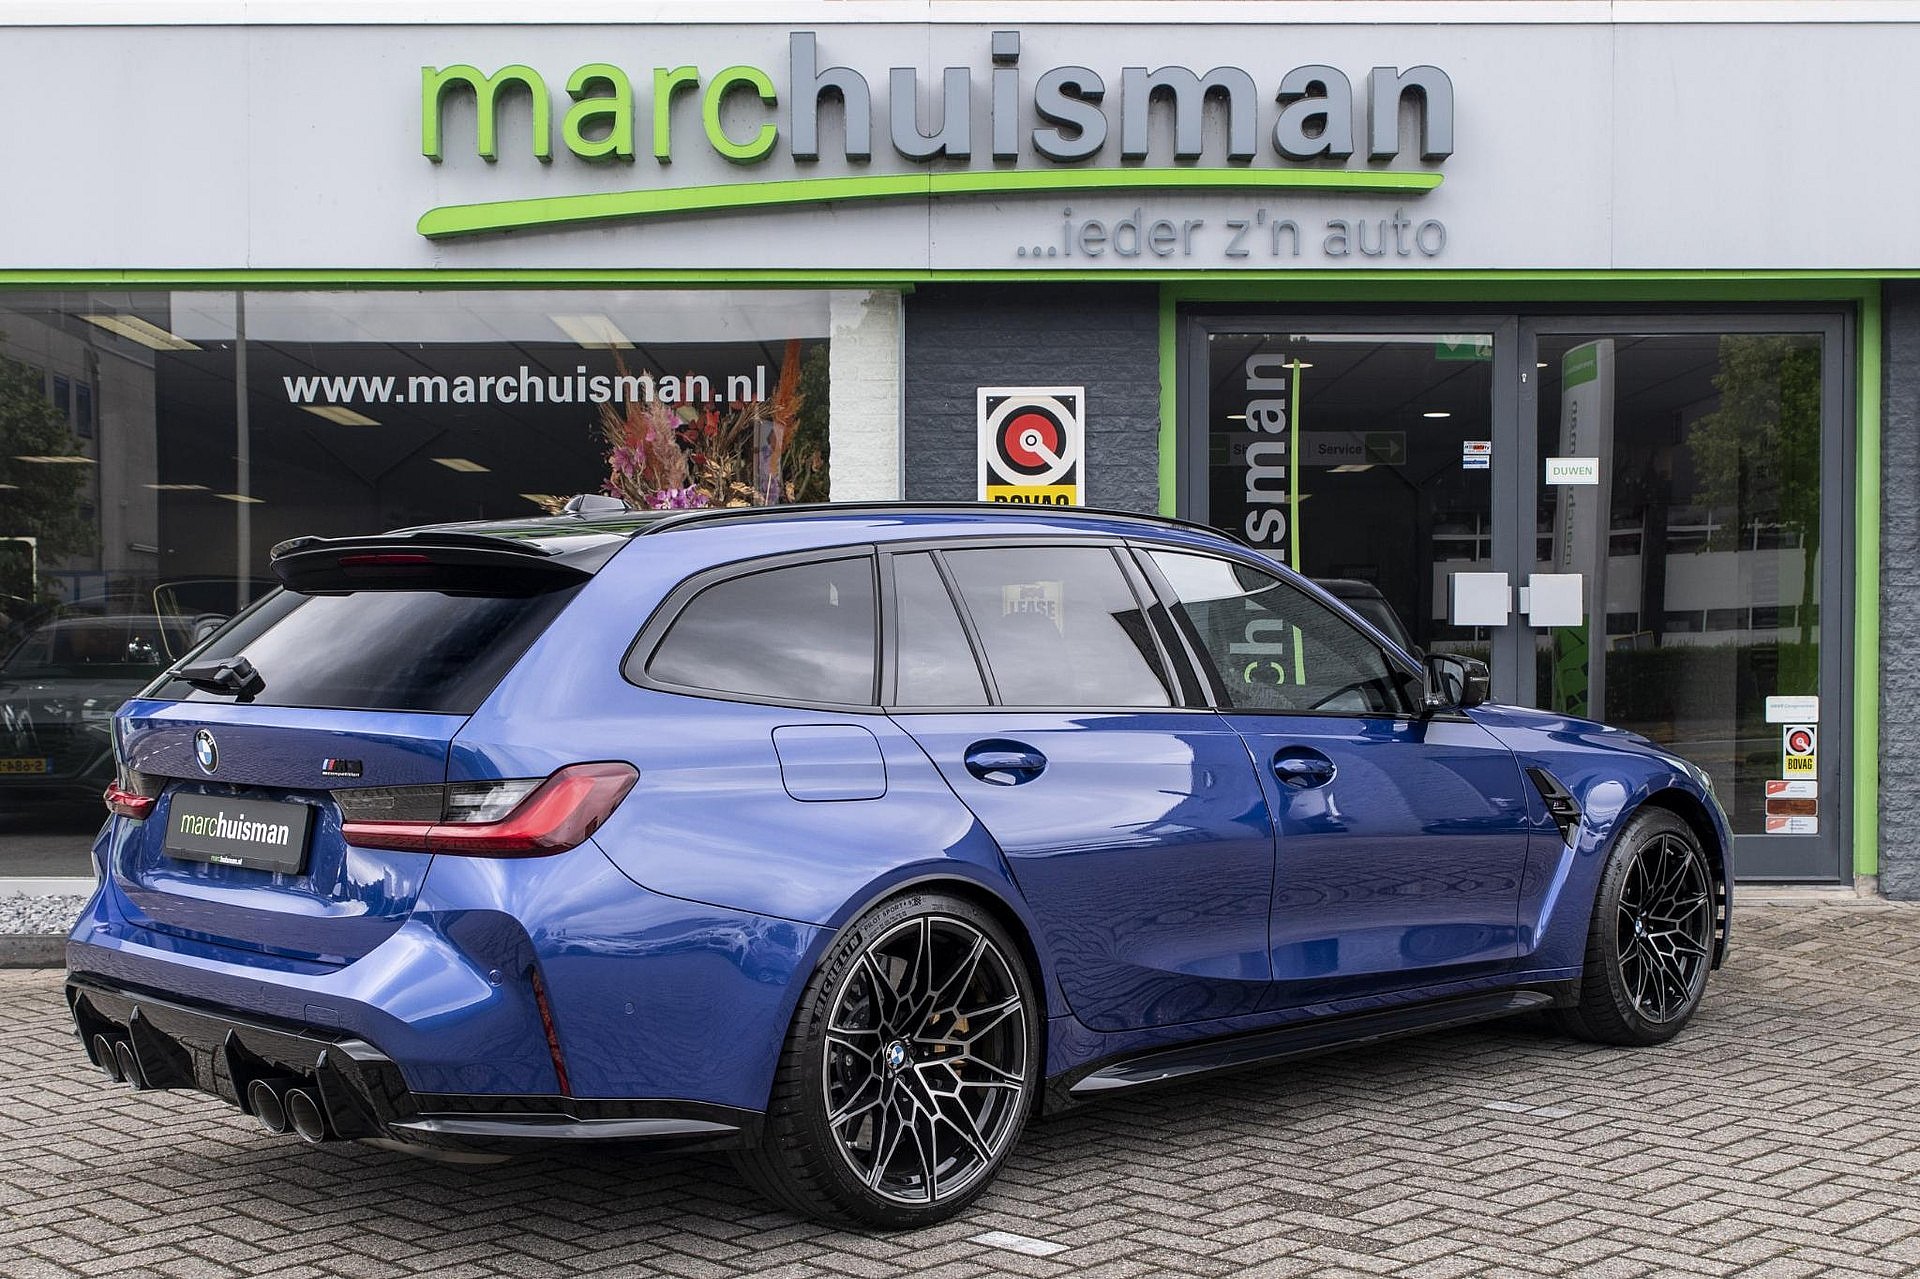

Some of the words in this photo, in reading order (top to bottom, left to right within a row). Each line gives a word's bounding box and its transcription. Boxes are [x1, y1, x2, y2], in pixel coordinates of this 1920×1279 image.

[421, 31, 1455, 164] marchuisman
[1225, 208, 1301, 257] z'n
[1323, 208, 1448, 257] auto
[283, 365, 767, 403] www.marchuisman.nl
[1318, 443, 1362, 456] Service
[1553, 465, 1593, 477] DUWEN
[1787, 758, 1813, 770] BOVAG
[181, 812, 289, 845] marchuisman
[814, 930, 862, 1019] MICHELIN
